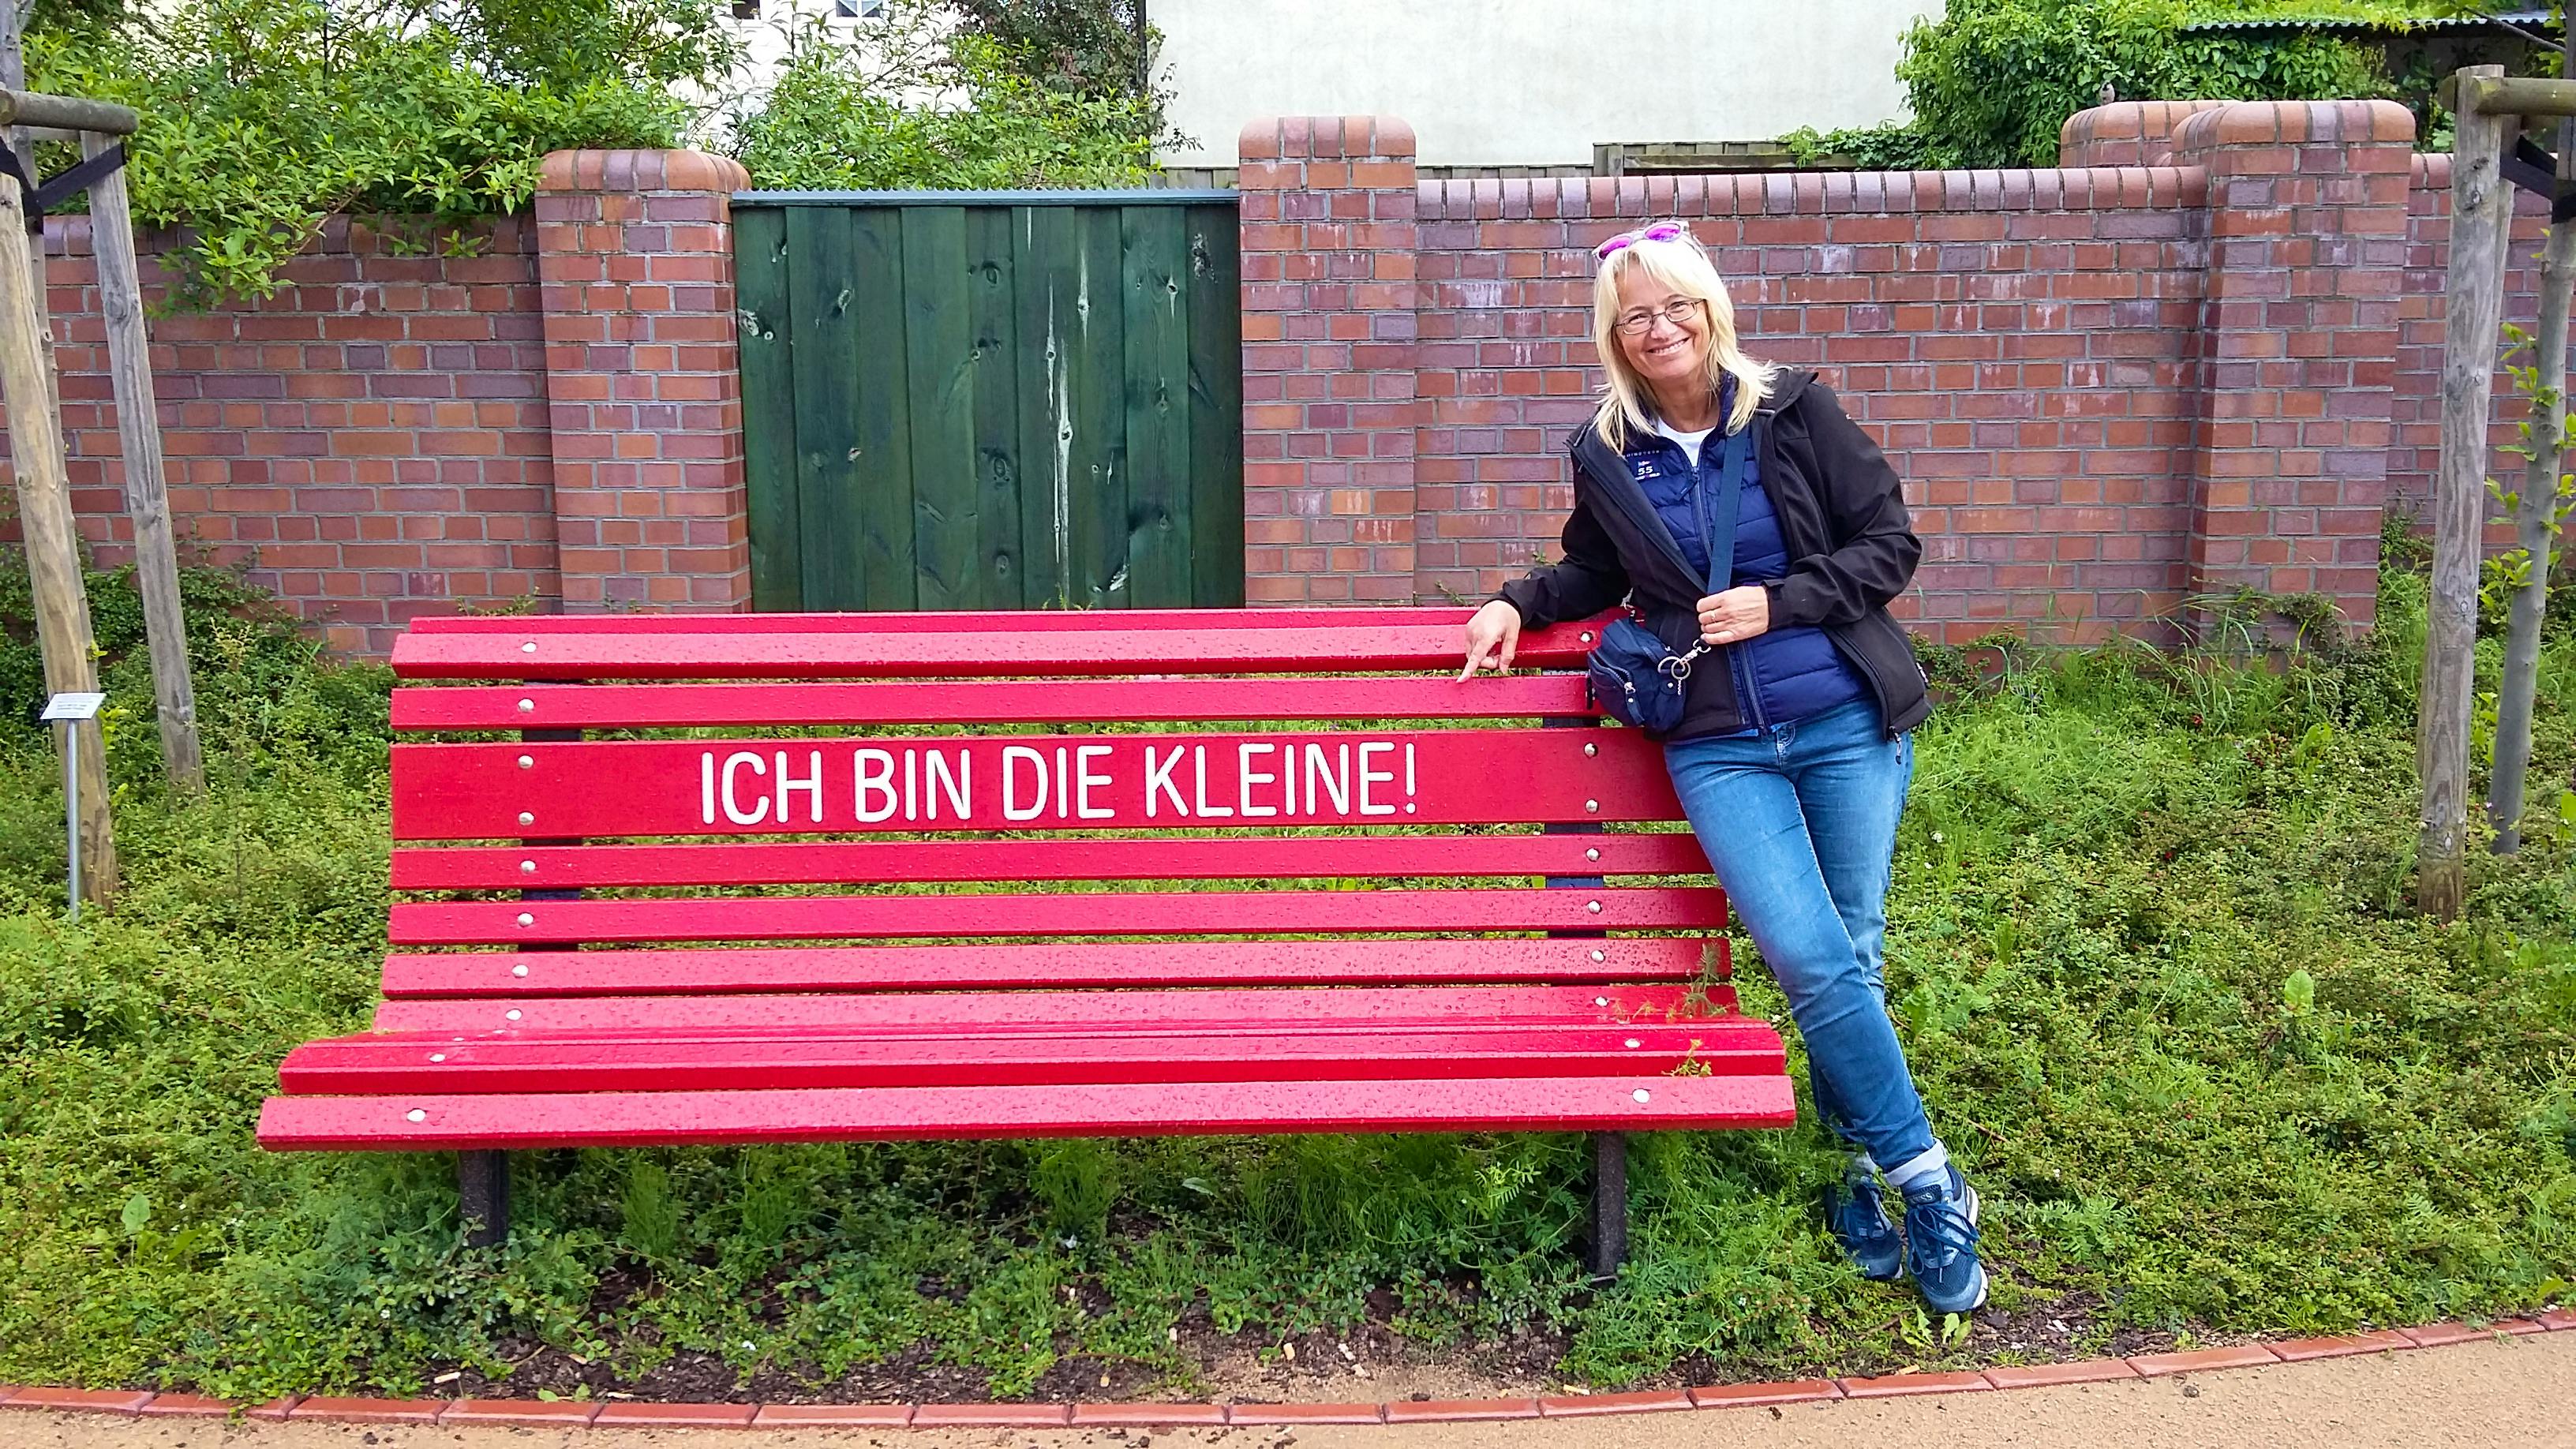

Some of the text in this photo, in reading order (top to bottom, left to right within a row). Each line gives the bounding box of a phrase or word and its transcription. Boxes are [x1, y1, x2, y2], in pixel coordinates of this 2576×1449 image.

[701, 741, 1417, 826] ICH BIN DIE KLEINE!
